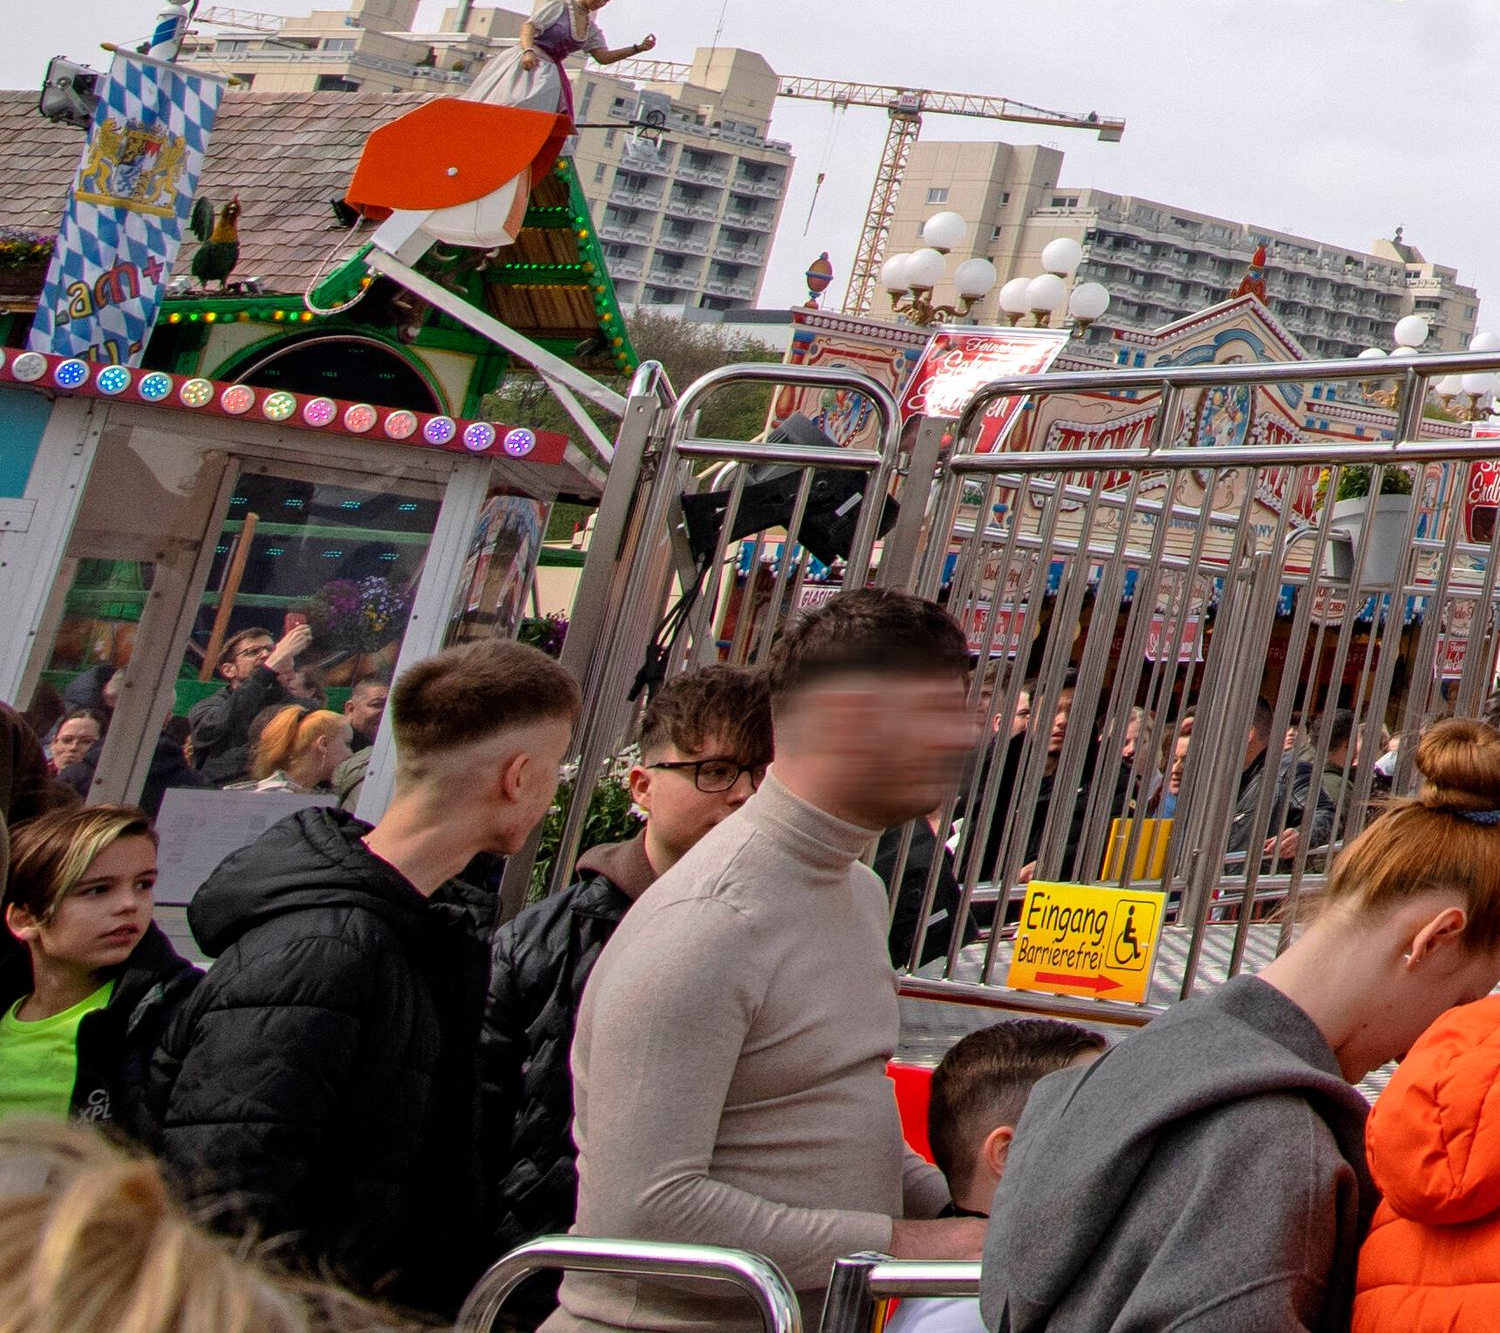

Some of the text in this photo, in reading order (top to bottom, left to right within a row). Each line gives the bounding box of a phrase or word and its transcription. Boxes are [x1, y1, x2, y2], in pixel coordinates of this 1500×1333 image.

[1313, 598, 1346, 613] MÜCHEN
[1026, 891, 1109, 947] Eingang
[1018, 936, 1105, 970] Barrierefrei
